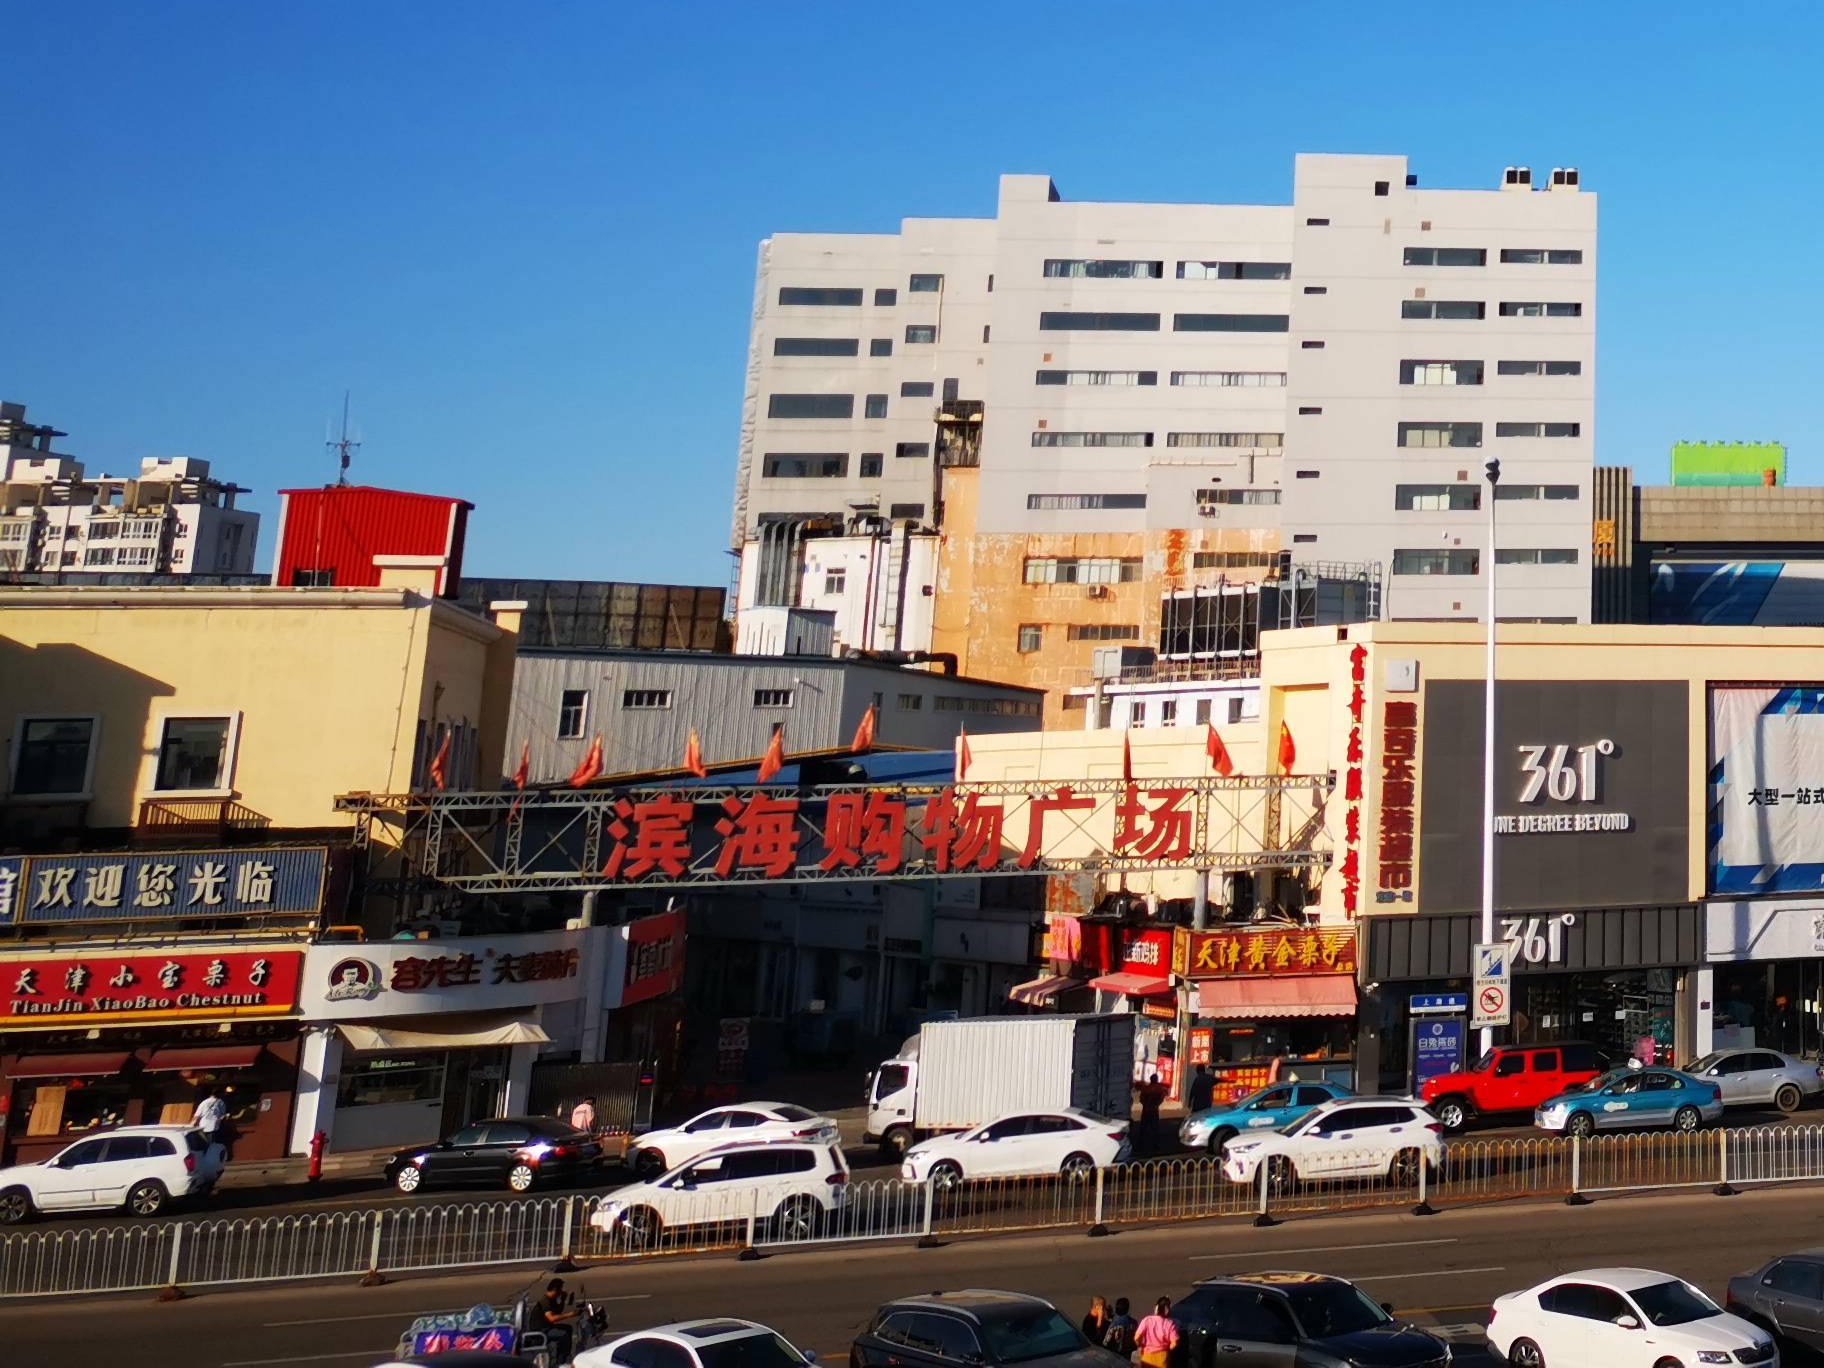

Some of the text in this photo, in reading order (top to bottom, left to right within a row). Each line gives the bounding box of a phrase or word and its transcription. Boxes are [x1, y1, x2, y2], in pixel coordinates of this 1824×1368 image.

[602, 786, 1196, 878] 滨海购物广场
[1519, 814, 1573, 832] DEGREE
[1574, 813, 1629, 831] BEYOND
[32, 860, 277, 910] 欢迎您光临
[1196, 935, 1340, 970] 天津黄金栗子
[14, 959, 270, 994] 天津小宝栗子
[10, 991, 263, 1015] TianJin XiaoBao Chestnut
